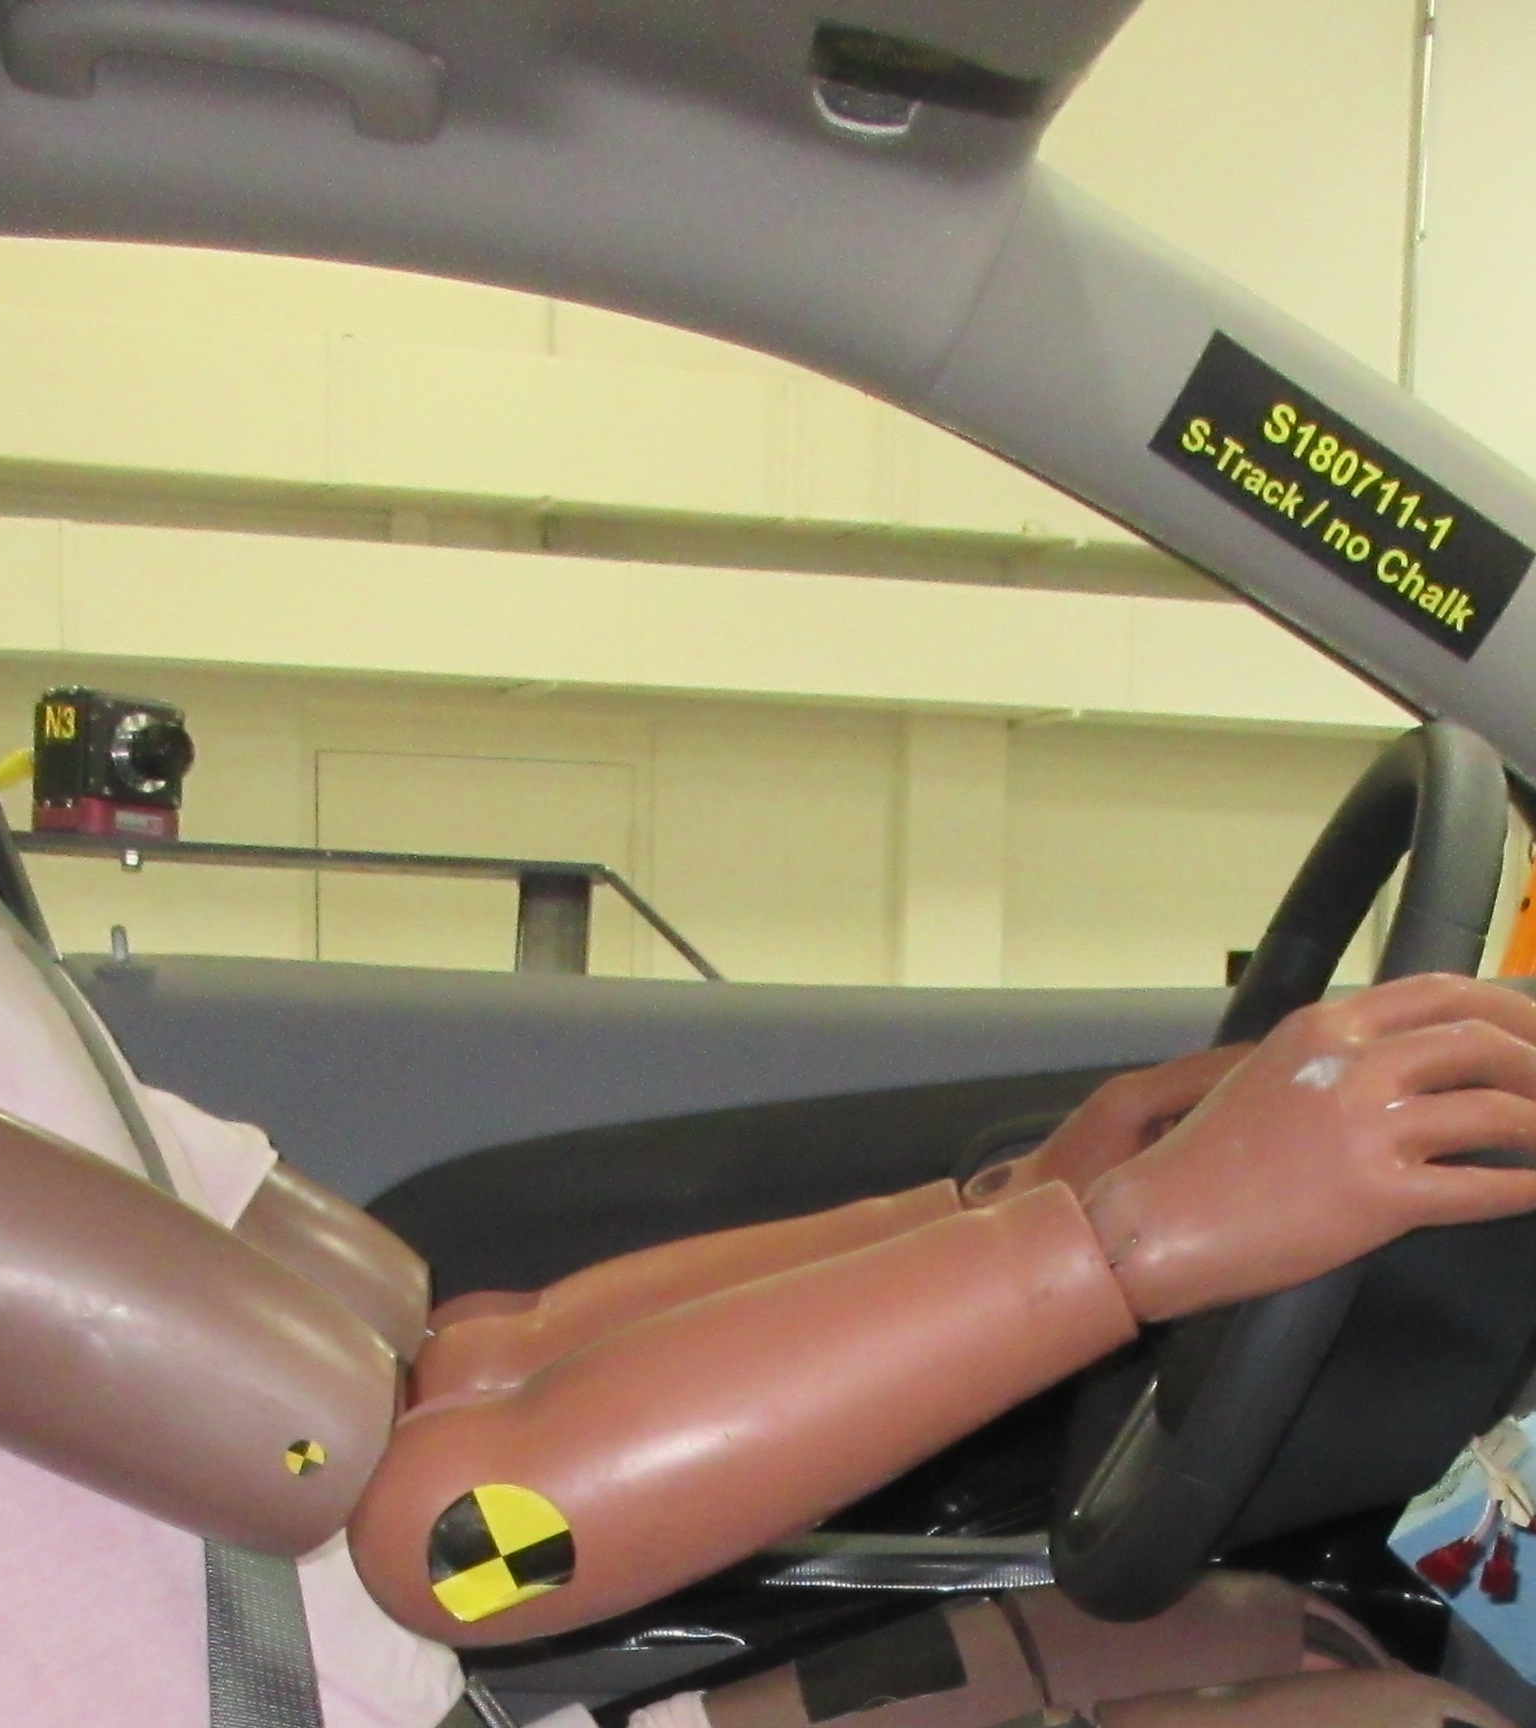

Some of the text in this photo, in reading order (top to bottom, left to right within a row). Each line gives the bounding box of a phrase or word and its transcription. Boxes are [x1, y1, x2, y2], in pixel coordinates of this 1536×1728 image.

[1181, 418, 1475, 632] S-Track / no Chalk
[1264, 403, 1455, 551] S180711-1
[45, 704, 76, 739] N3
